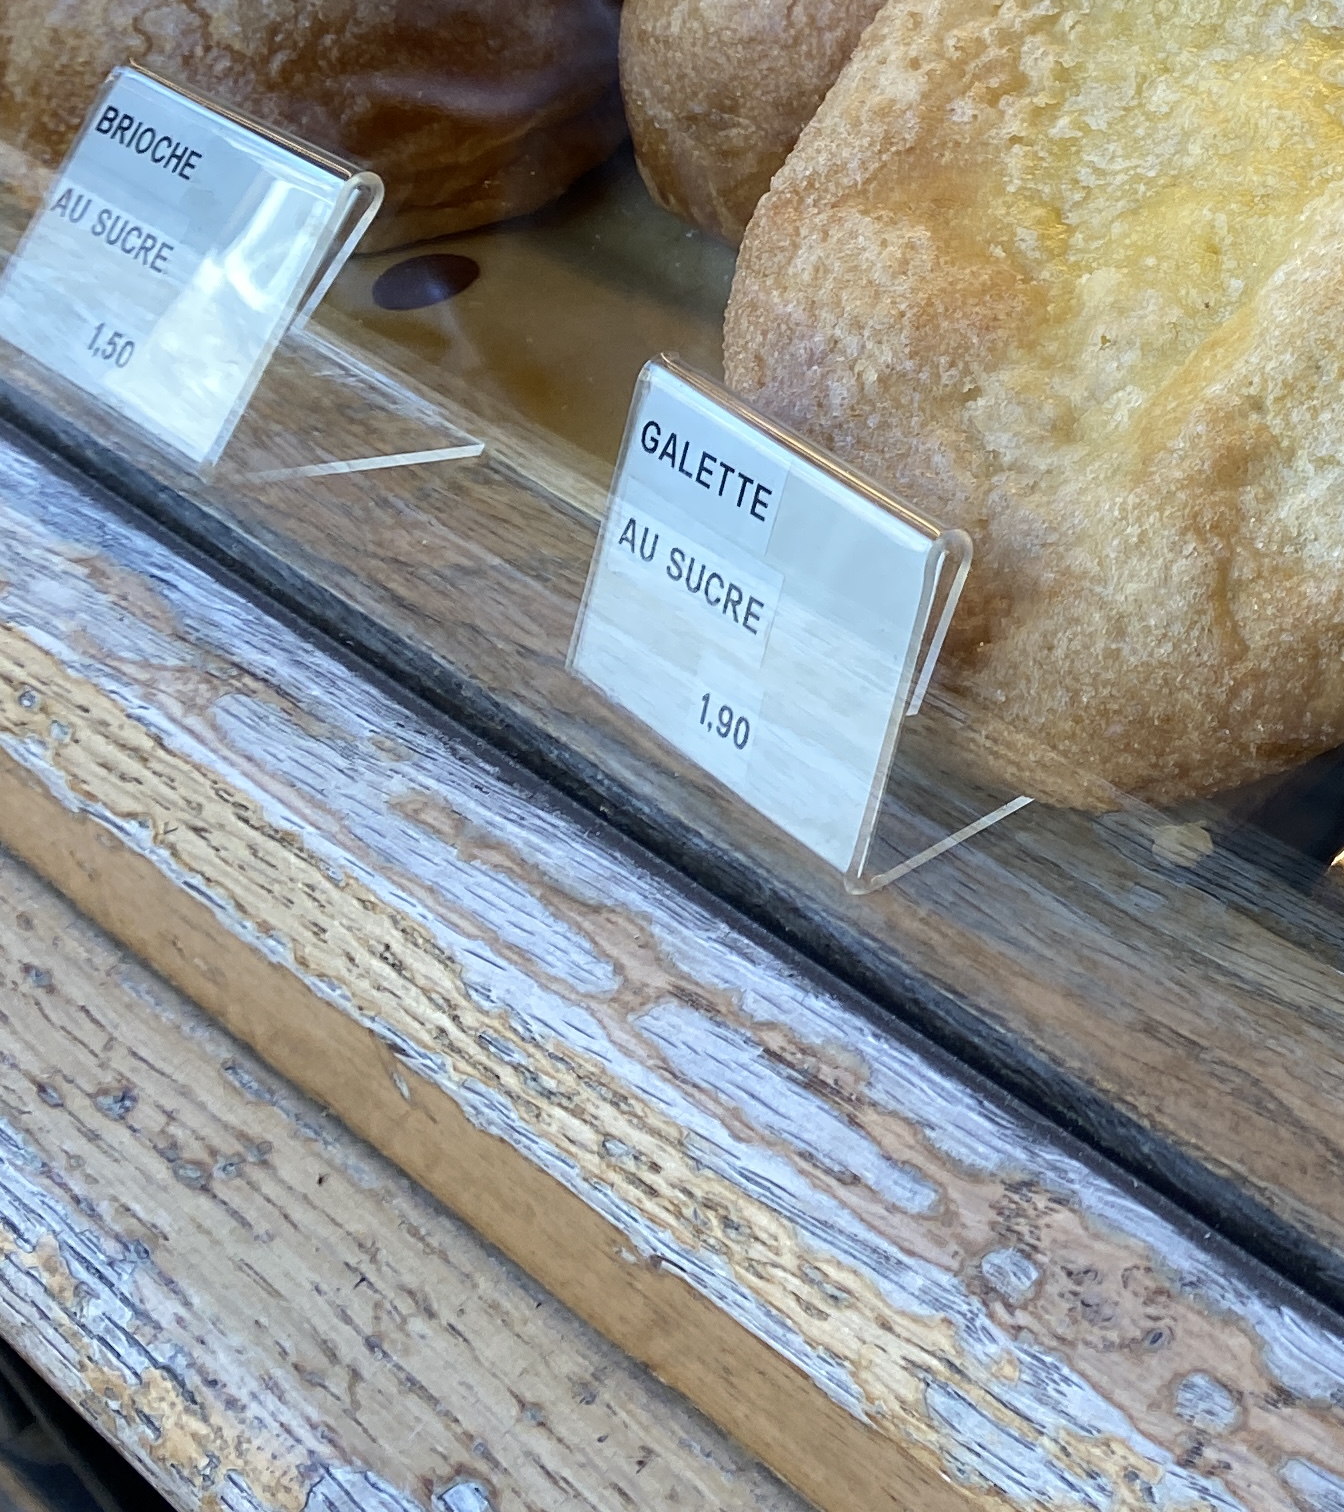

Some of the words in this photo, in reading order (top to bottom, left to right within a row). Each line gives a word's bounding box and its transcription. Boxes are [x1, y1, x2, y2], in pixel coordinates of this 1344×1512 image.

[95, 105, 203, 180] BRIOCHE
[50, 187, 91, 224] AU
[91, 209, 174, 274] SUCRE
[86, 322, 136, 369] 1,50
[640, 420, 773, 522] GALETTE
[618, 517, 660, 562] AU
[666, 547, 765, 635] SUCRE
[698, 692, 751, 750] 1,90
